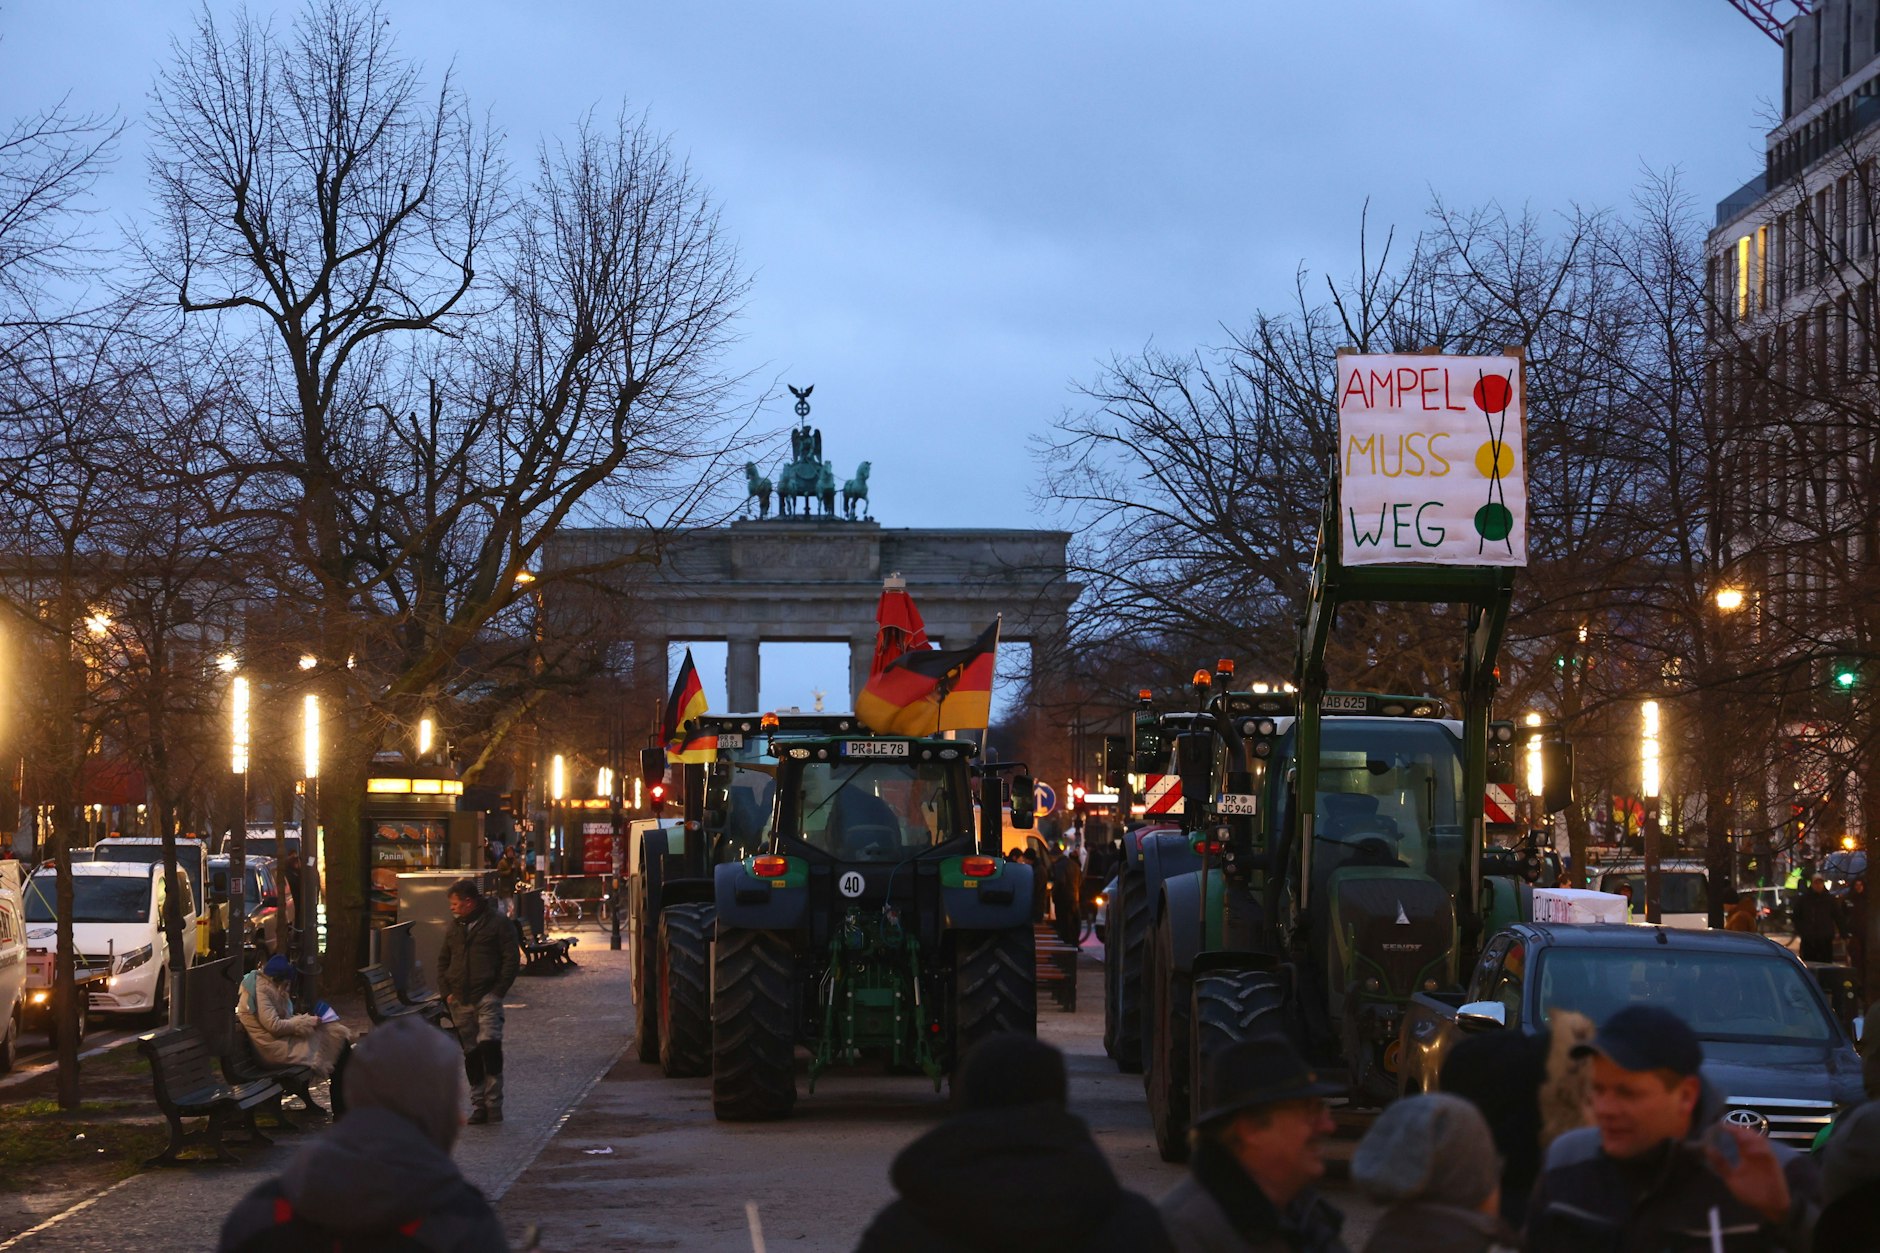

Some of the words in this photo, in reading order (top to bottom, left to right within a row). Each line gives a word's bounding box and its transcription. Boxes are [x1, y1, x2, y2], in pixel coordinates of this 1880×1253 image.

[1341, 367, 1466, 411] AMPEL
[1345, 431, 1450, 478] MUSS
[1349, 501, 1445, 548] WEG
[1326, 696, 1341, 708] AB
[1343, 697, 1365, 709] 625
[851, 743, 866, 754] PR
[873, 743, 888, 755] LE
[890, 743, 904, 755] 78
[1225, 795, 1237, 804] PR
[379, 851, 404, 861] Panini
[844, 876, 859, 893] 40
